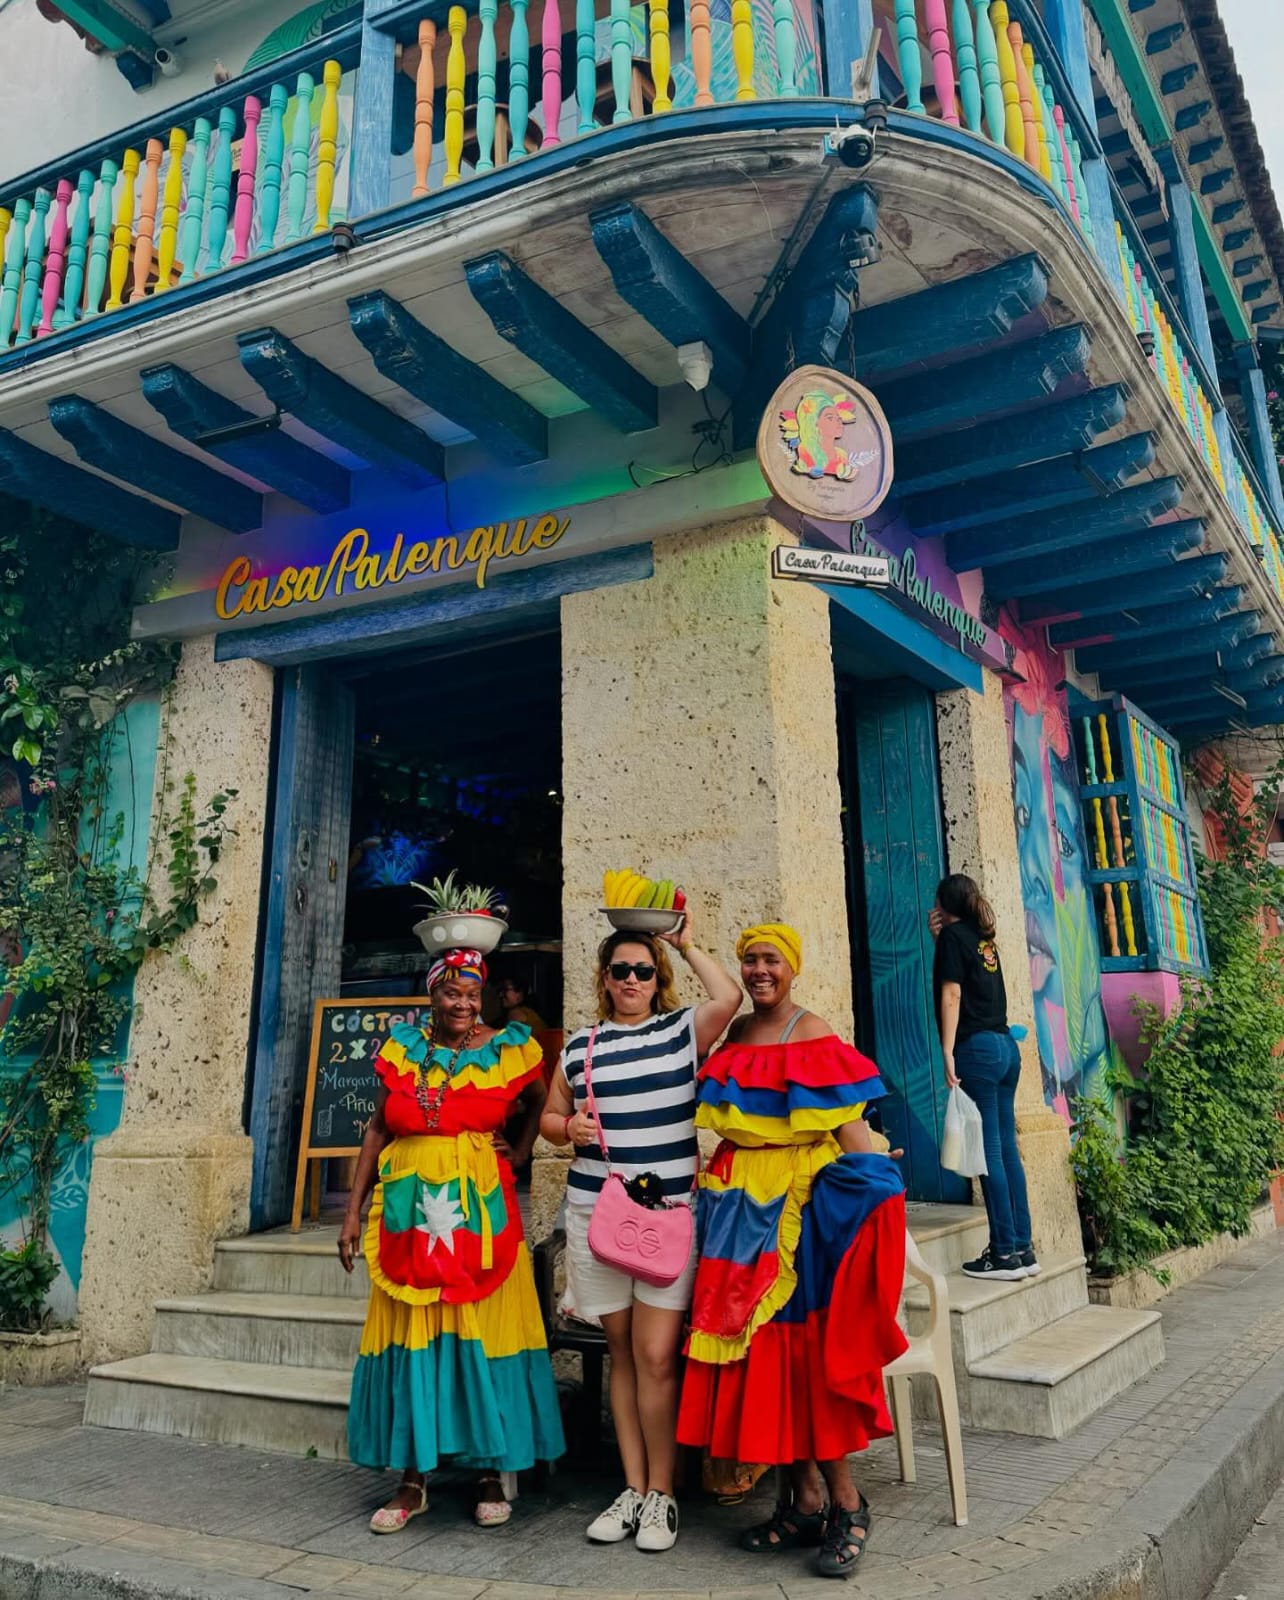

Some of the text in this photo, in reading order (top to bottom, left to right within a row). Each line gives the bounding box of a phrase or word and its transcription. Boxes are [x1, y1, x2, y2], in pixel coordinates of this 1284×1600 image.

[215, 512, 571, 620] Casa Palenque
[785, 551, 887, 579] Casa Palenque
[902, 547, 986, 654] Palenque
